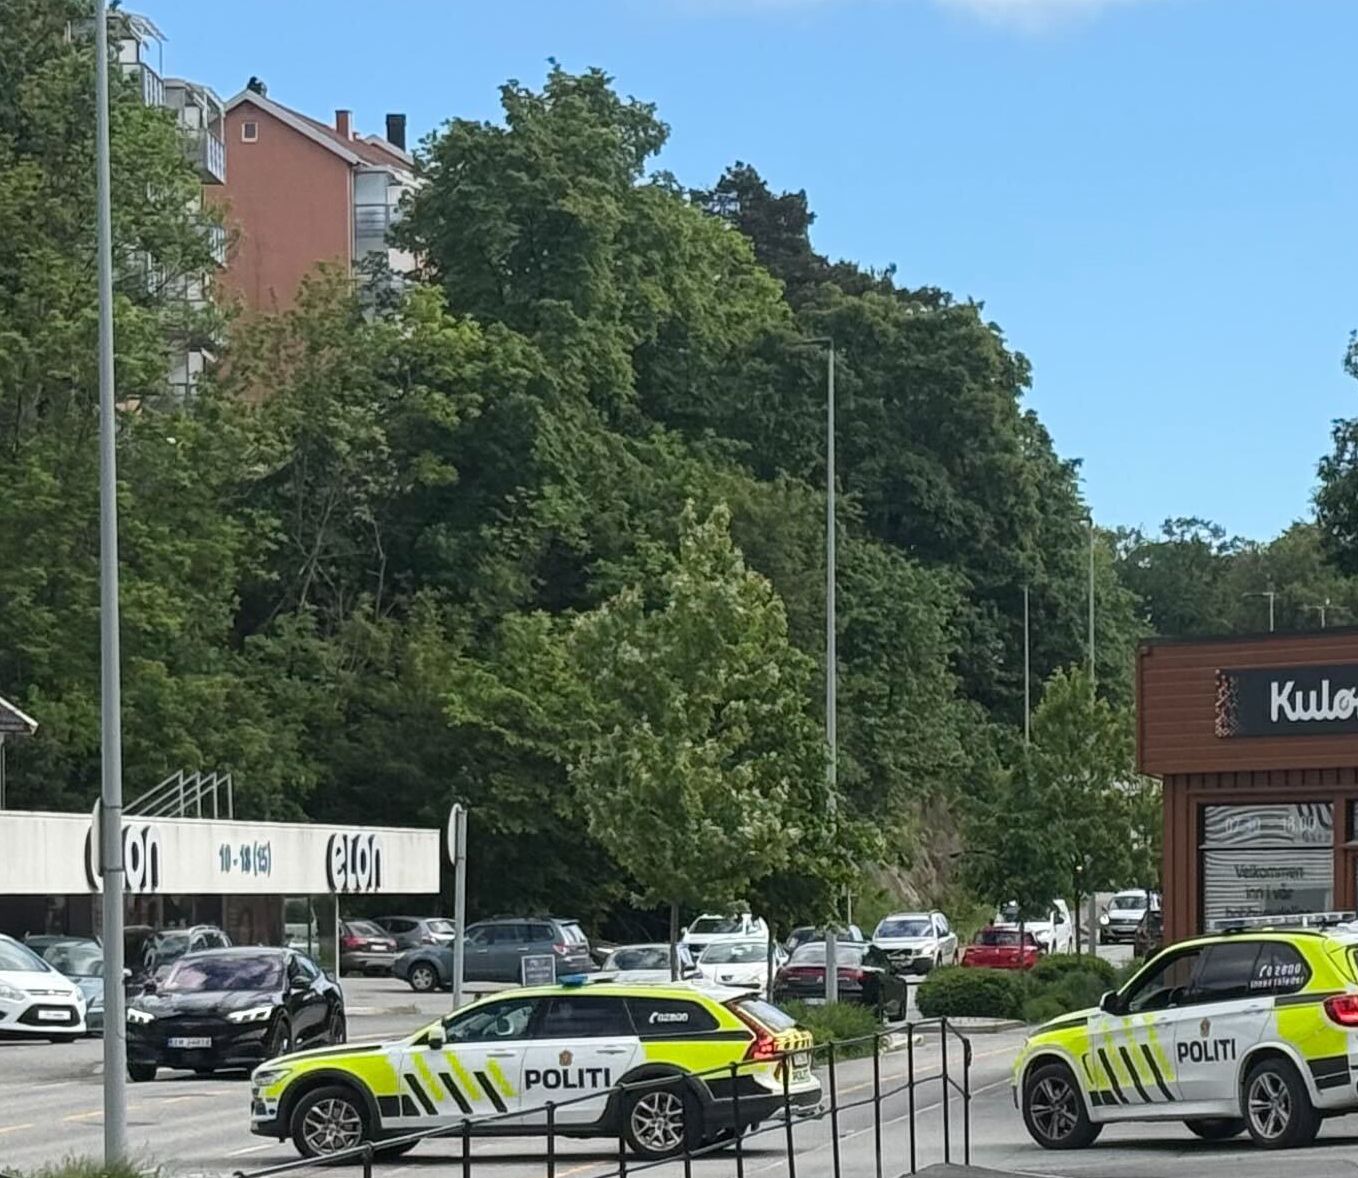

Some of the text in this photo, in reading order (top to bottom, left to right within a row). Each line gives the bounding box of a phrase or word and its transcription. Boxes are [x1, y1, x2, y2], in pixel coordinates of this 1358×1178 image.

[219, 843, 231, 873] 10
[240, 844, 251, 873] 18
[1266, 963, 1301, 977] 02800
[1177, 1038, 1236, 1063] POLITI
[525, 1067, 610, 1090] POLITI
